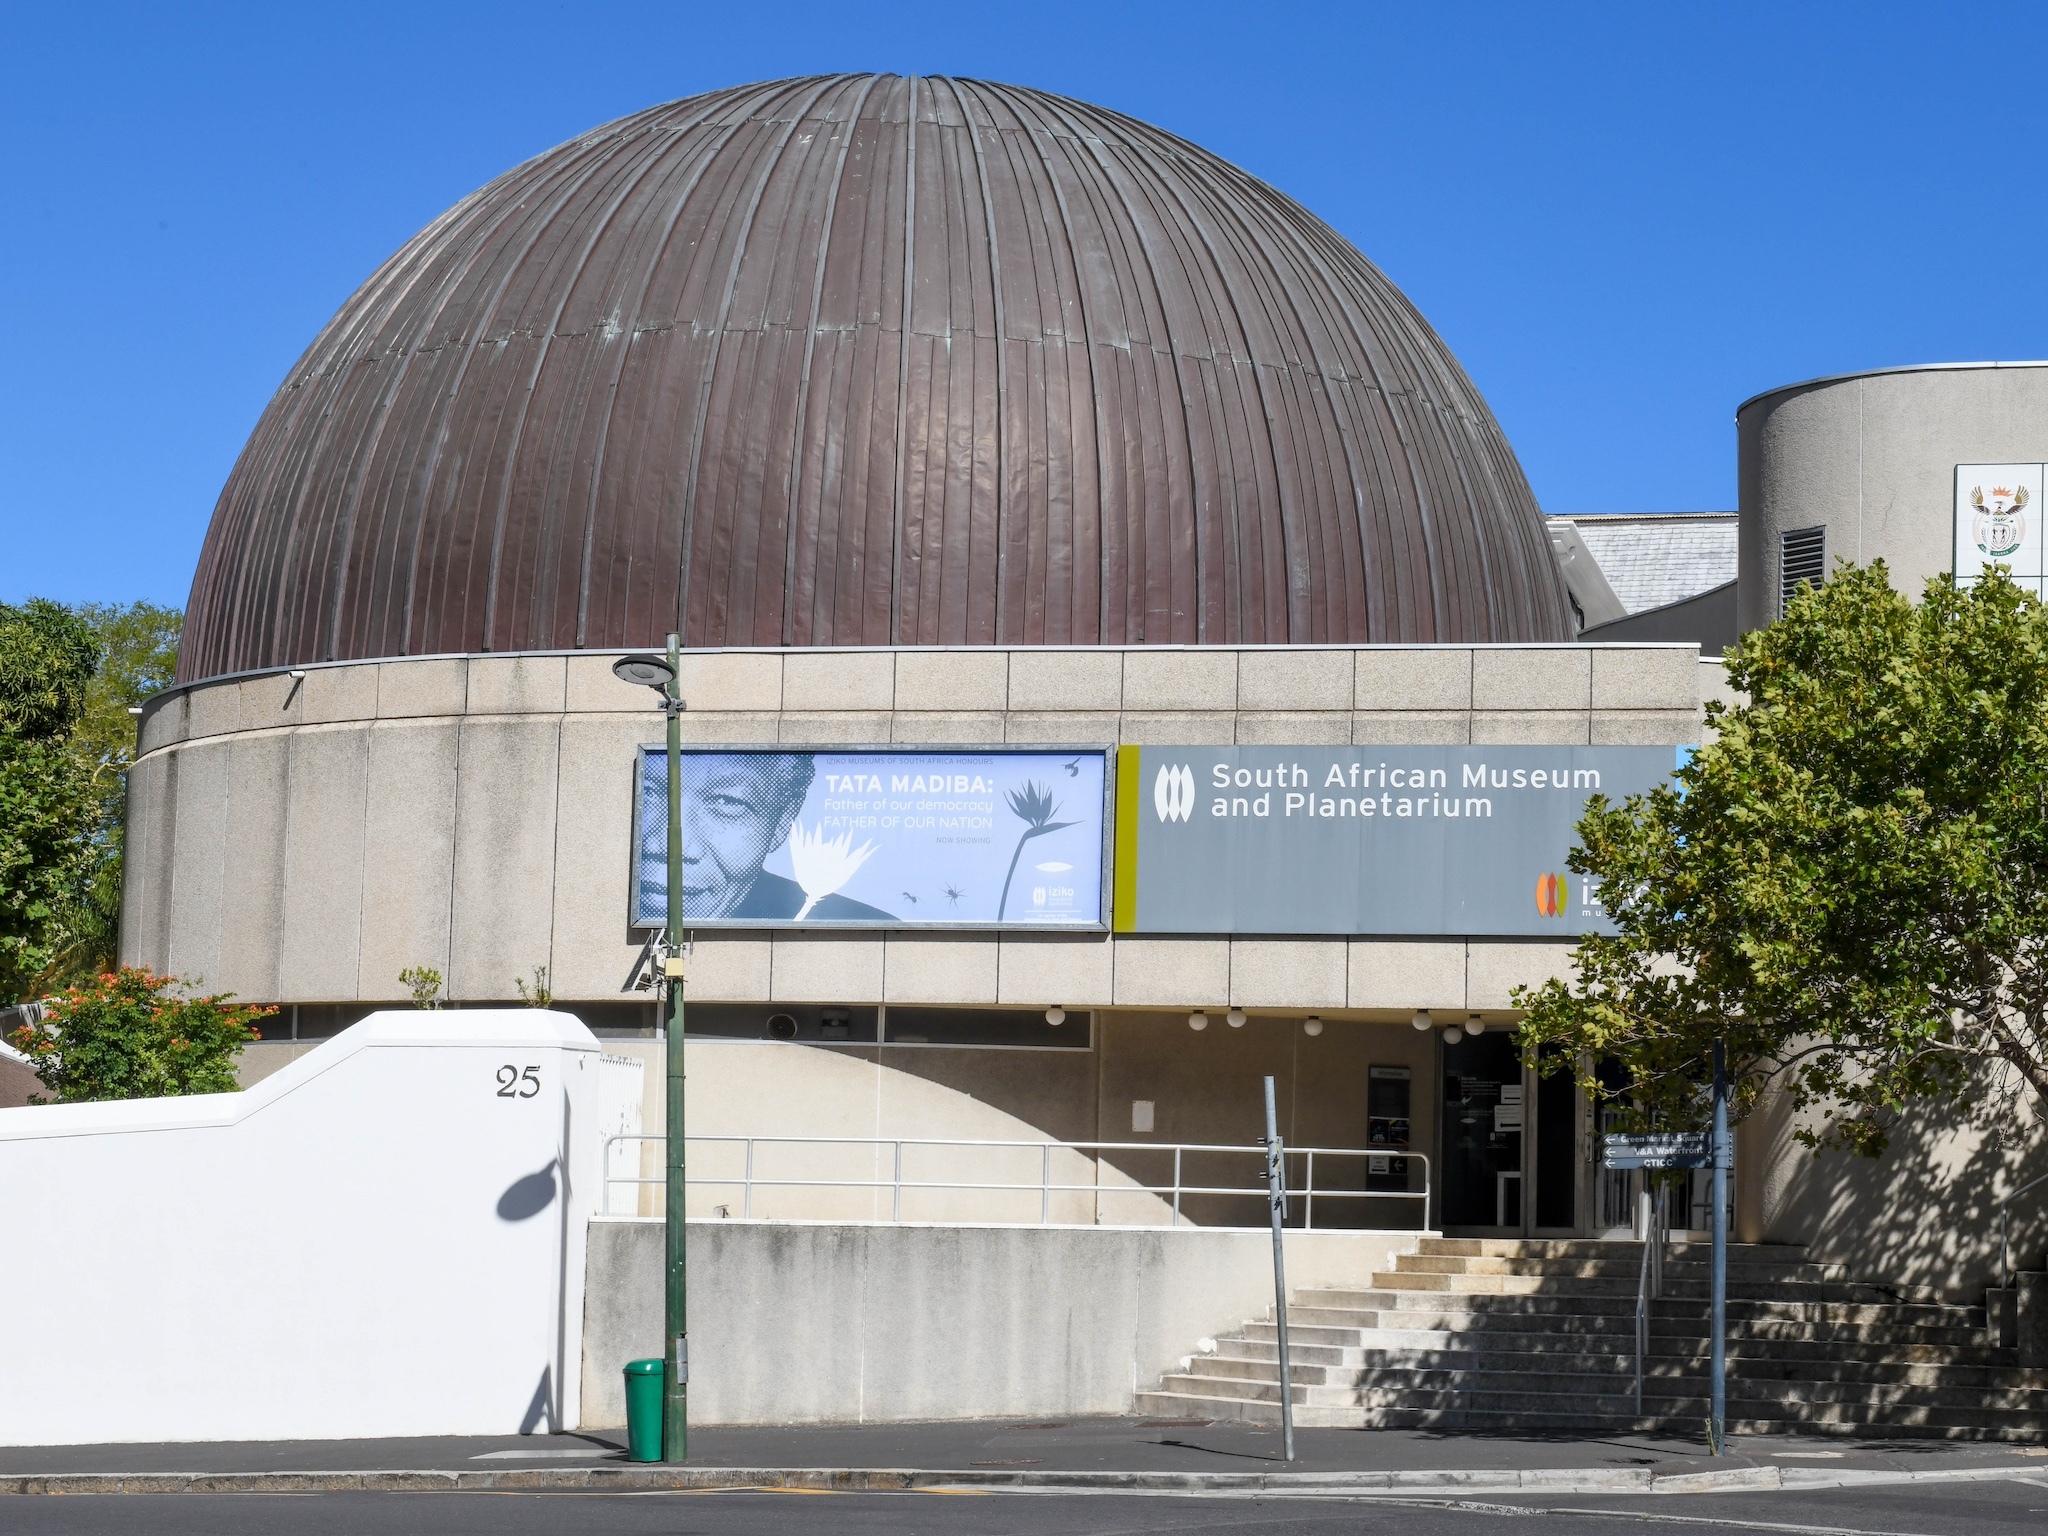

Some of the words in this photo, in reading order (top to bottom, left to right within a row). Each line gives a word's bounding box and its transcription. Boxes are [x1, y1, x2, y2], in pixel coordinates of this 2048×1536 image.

[1212, 763, 1309, 788] South
[1324, 763, 1447, 788] African
[1462, 764, 1601, 789] Museum
[825, 775, 883, 793] TATA
[891, 775, 994, 793] MADIBA:
[824, 799, 869, 811] Father
[873, 799, 888, 811] of
[890, 801, 912, 811] our
[916, 799, 993, 813] democracy
[1211, 792, 1270, 817] and
[1285, 791, 1492, 817] Planetarium
[824, 816, 877, 828] FATHER
[880, 816, 901, 828] OF
[904, 816, 936, 828] OUR
[939, 816, 993, 829] NATION
[1048, 886, 1075, 897] iziko
[496, 1064, 541, 1099] 25
[1646, 1135, 1674, 1143] Market
[1676, 1134, 1705, 1143] Square
[1634, 1148, 1653, 1156] V&A
[1656, 1146, 1704, 1155] Waterfront
[1643, 1158, 1673, 1167] CTICC
